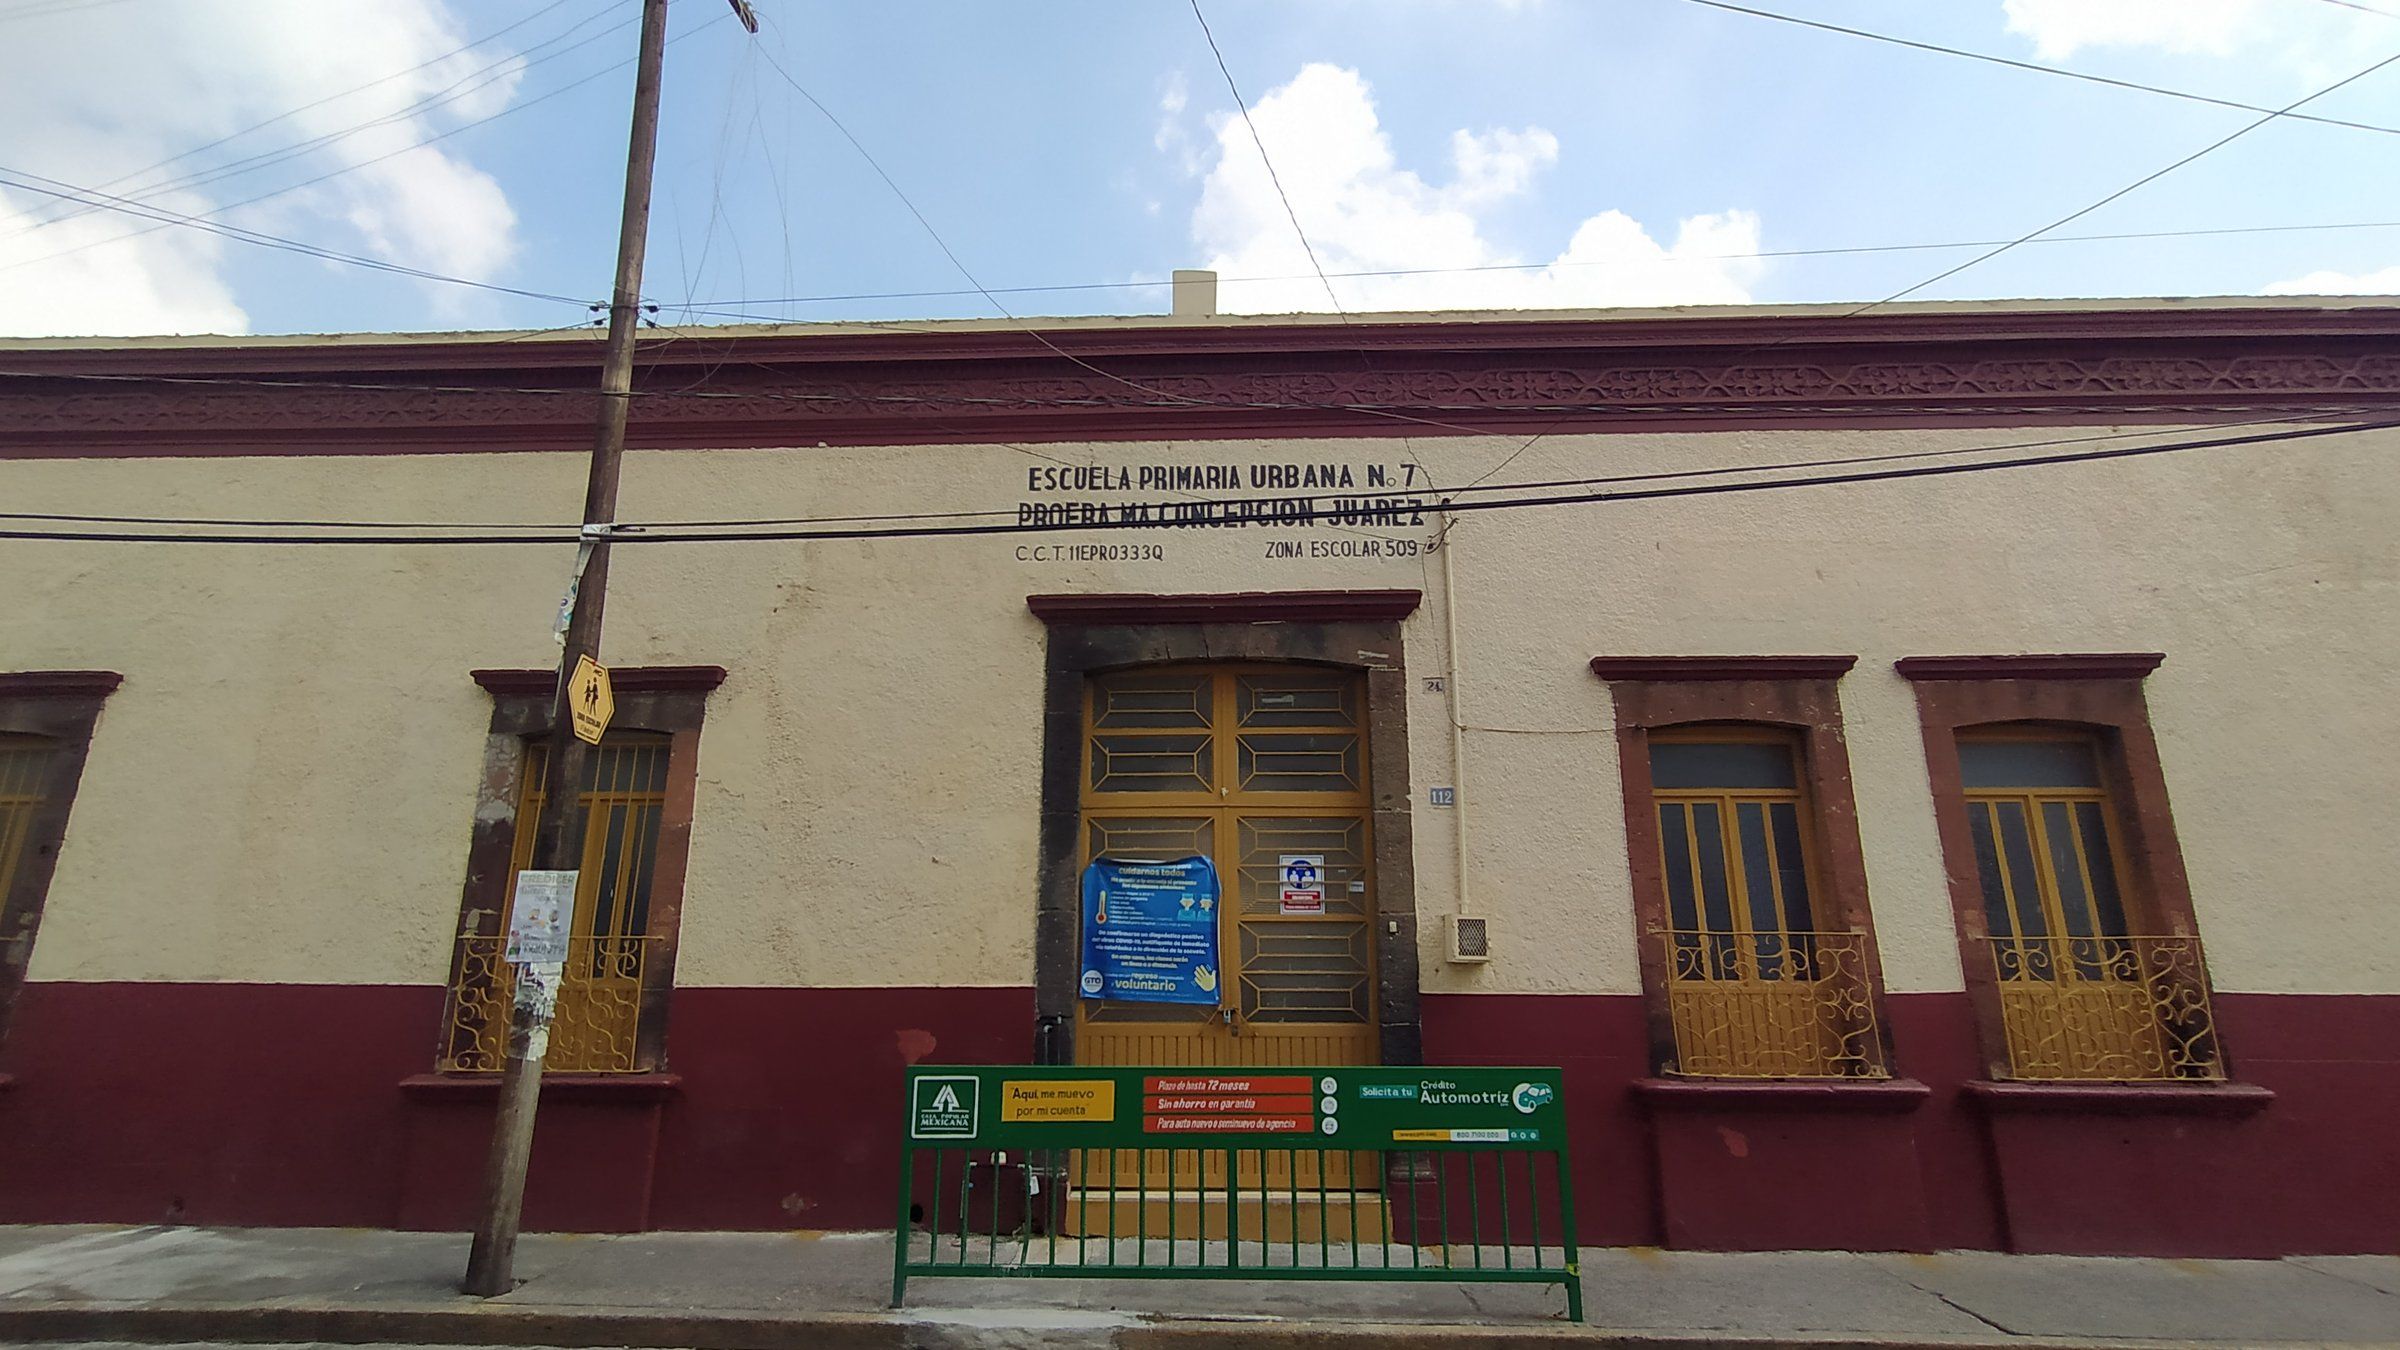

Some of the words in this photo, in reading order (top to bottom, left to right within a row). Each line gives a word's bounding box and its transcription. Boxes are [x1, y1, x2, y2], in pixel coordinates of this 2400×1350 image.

[1029, 465, 1131, 491] ESCUELA
[1139, 465, 1241, 490] PRIMARIA
[1251, 464, 1354, 488] URBANA
[1400, 464, 1416, 487] 7
[1327, 499, 1424, 527] JUAREZ
[1266, 541, 1303, 559] ZONA
[1311, 541, 1381, 558] ESCOLAR
[1385, 539, 1417, 557] 509
[1432, 790, 1452, 803] 112
[1161, 868, 1185, 877] todos
[1115, 978, 1176, 991] voluntario
[1177, 1081, 1185, 1091] de
[1186, 1081, 1206, 1090] hasta
[1207, 1080, 1219, 1090] 72
[1218, 1082, 1250, 1091] meses
[1362, 1086, 1399, 1096] Solicita
[1401, 1087, 1413, 1096] tu
[1420, 1080, 1456, 1090] Crédito
[1041, 1090, 1055, 1098] me
[1057, 1090, 1094, 1098] muevo
[1158, 1098, 1172, 1109] Sin
[1173, 1098, 1206, 1108] ahorro
[1208, 1100, 1219, 1108] en
[1016, 1107, 1034, 1119] por
[1036, 1106, 1048, 1115] mi
[1157, 1117, 1174, 1129] Para
[1174, 1118, 1191, 1128] auto
[1191, 1119, 1213, 1128] nuevo
[1218, 1118, 1255, 1129] seminuevo
[1256, 1118, 1266, 1128] de
[1266, 1118, 1296, 1131] agencia
